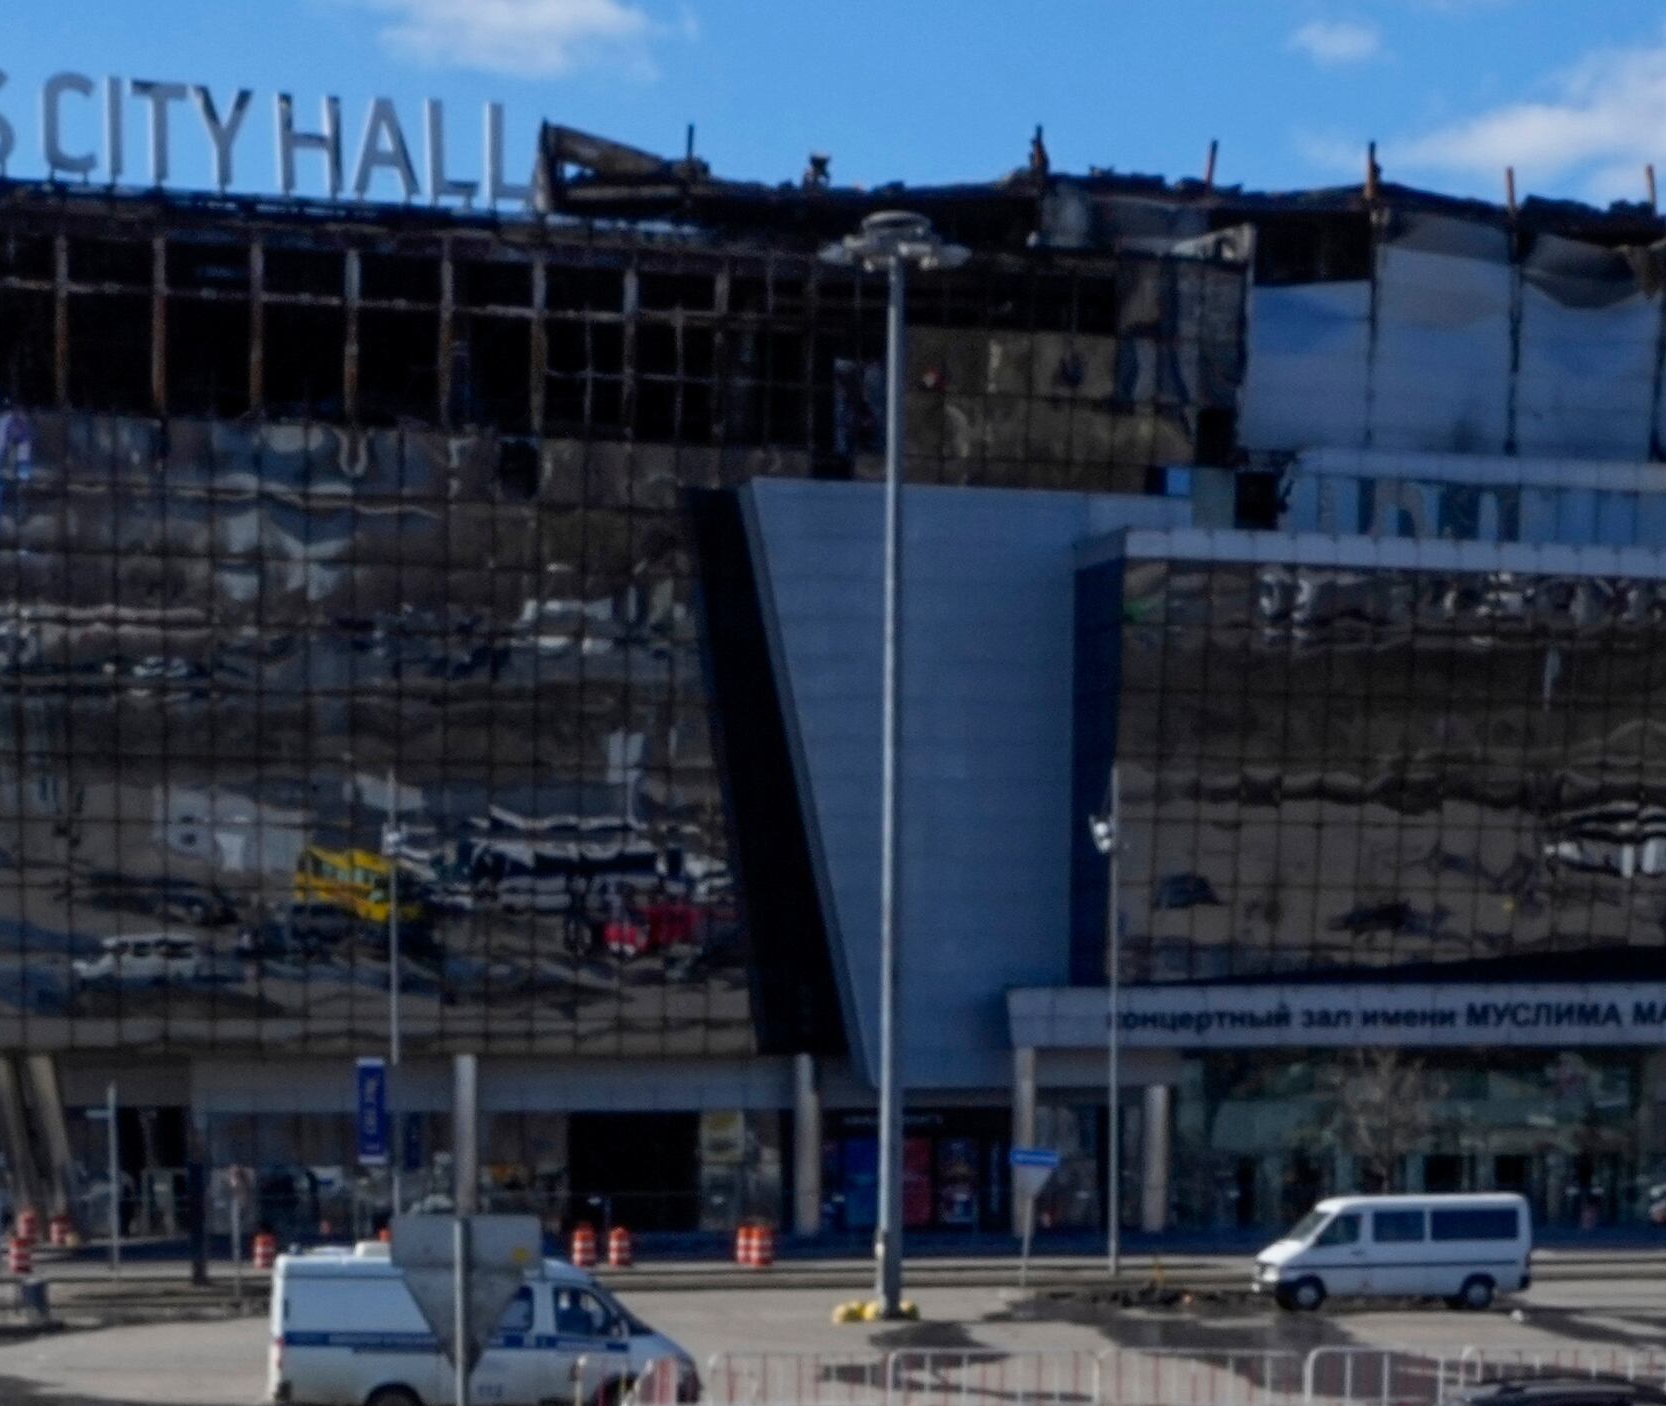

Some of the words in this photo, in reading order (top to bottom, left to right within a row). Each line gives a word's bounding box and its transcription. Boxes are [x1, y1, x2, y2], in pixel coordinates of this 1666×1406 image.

[41, 71, 253, 187] CITY
[273, 91, 536, 202] HALL
[1301, 1009, 1352, 1027] зал
[1361, 1009, 1457, 1027] имени
[1466, 1000, 1623, 1027] МУСЛИМА
